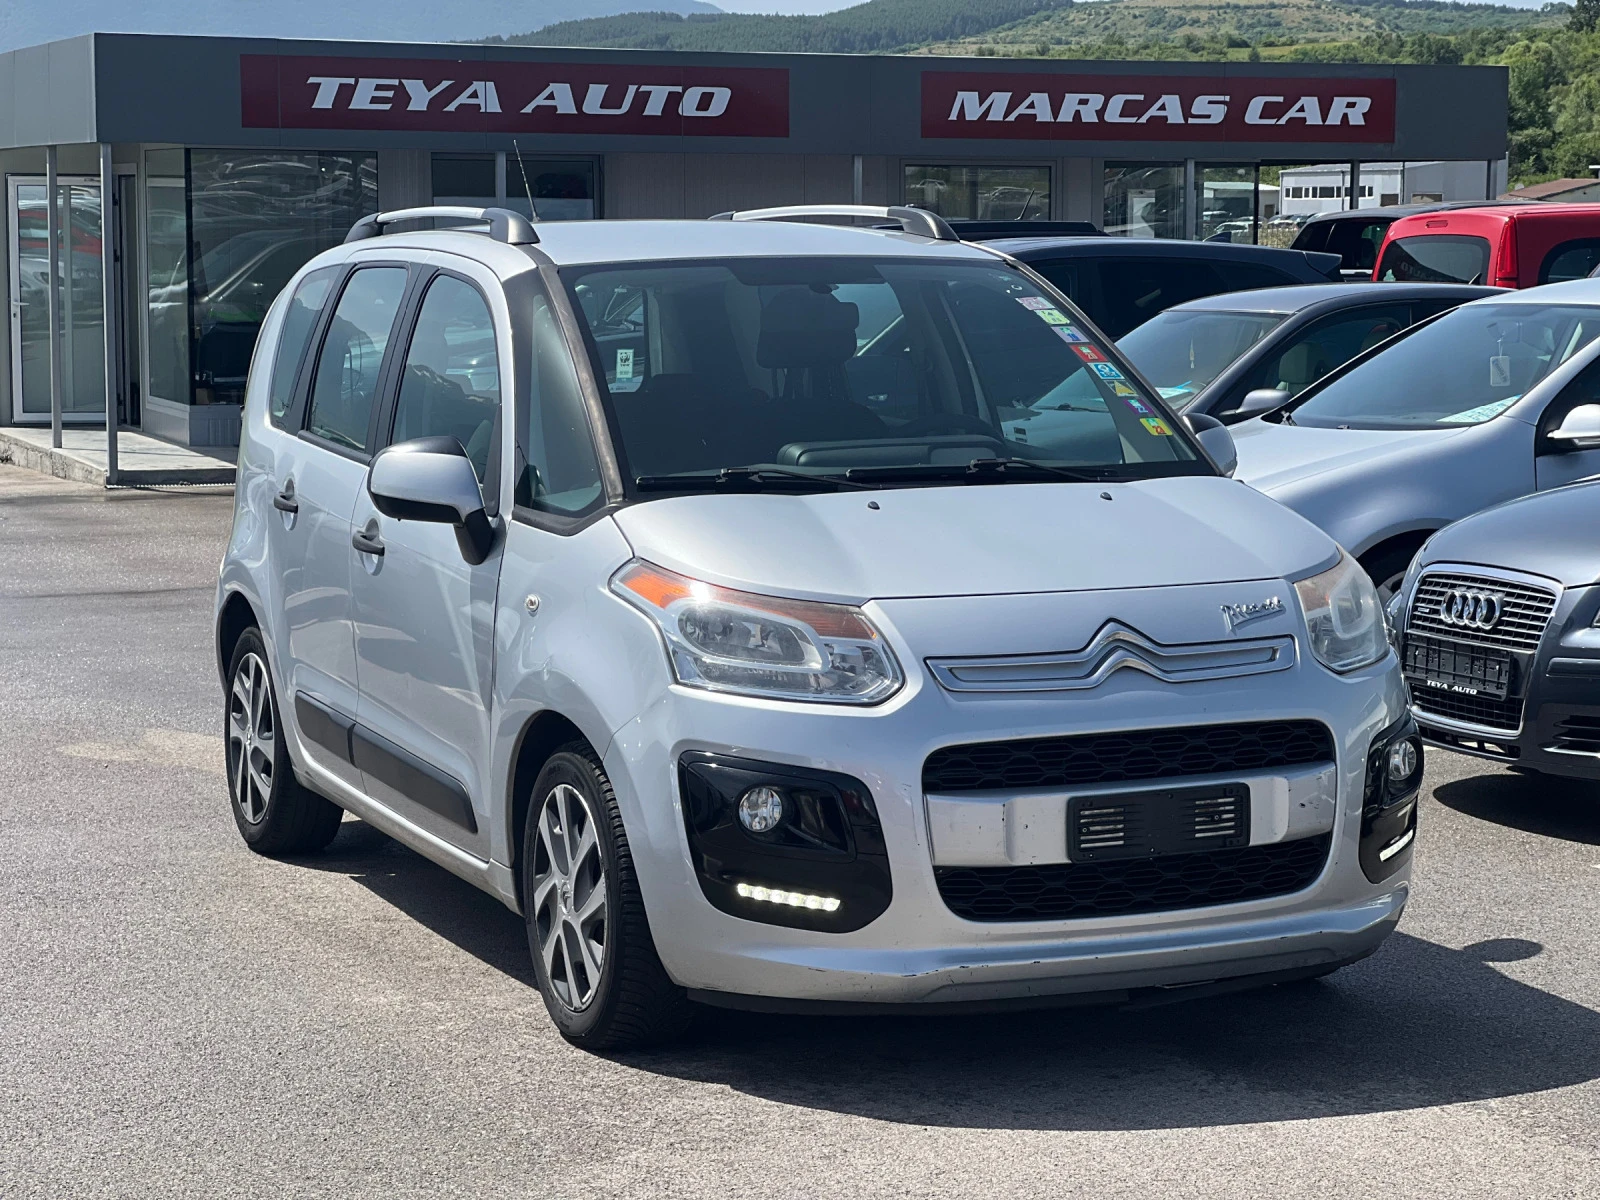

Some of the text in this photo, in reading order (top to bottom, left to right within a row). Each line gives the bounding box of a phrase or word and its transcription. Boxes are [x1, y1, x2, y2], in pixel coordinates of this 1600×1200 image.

[306, 77, 732, 117] TEYA AUTO
[948, 91, 1372, 125] MARCAS CAR
[1427, 680, 1478, 695] TEYA AUTO
